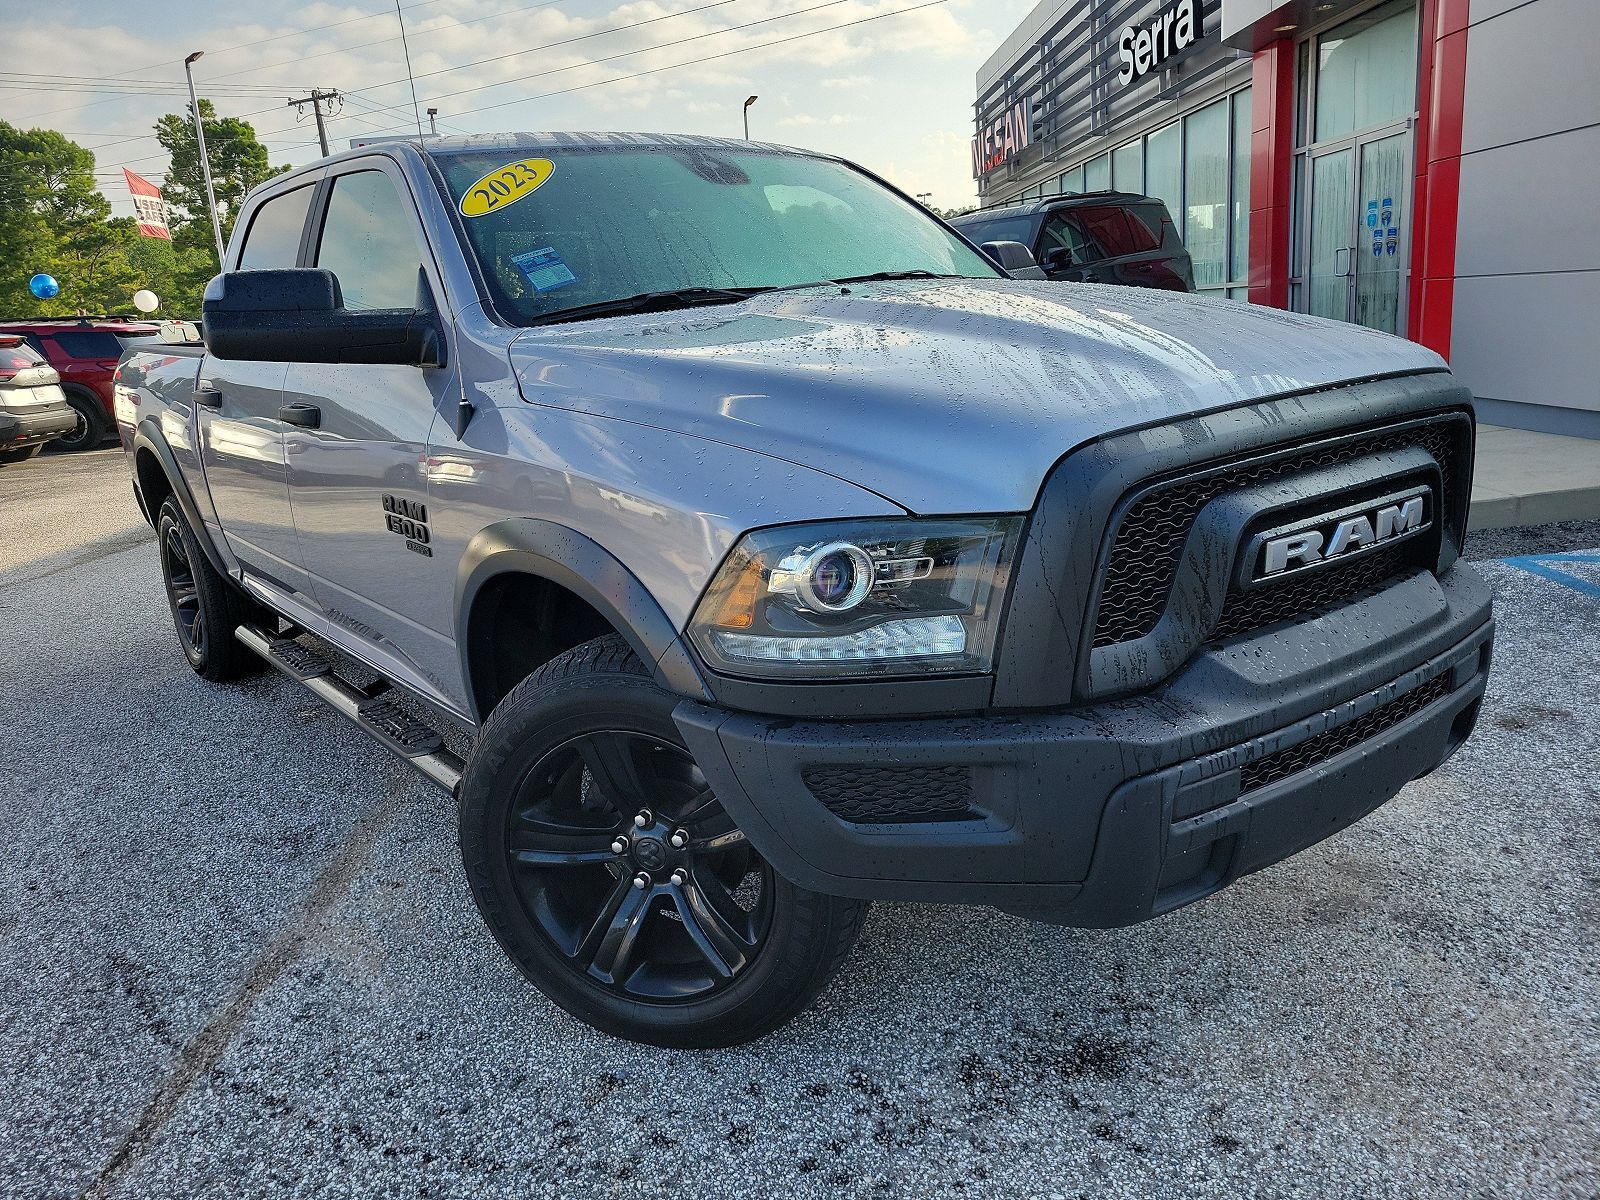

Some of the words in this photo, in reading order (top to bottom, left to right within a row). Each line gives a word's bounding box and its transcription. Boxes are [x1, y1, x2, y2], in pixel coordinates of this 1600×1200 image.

[1118, 0, 1196, 86] Serra
[971, 96, 1031, 178] NISSAN
[133, 198, 164, 212] USED
[474, 163, 538, 209] 2023
[381, 492, 429, 524] RAM
[384, 512, 432, 544] 1500
[1264, 495, 1424, 574] RAM
